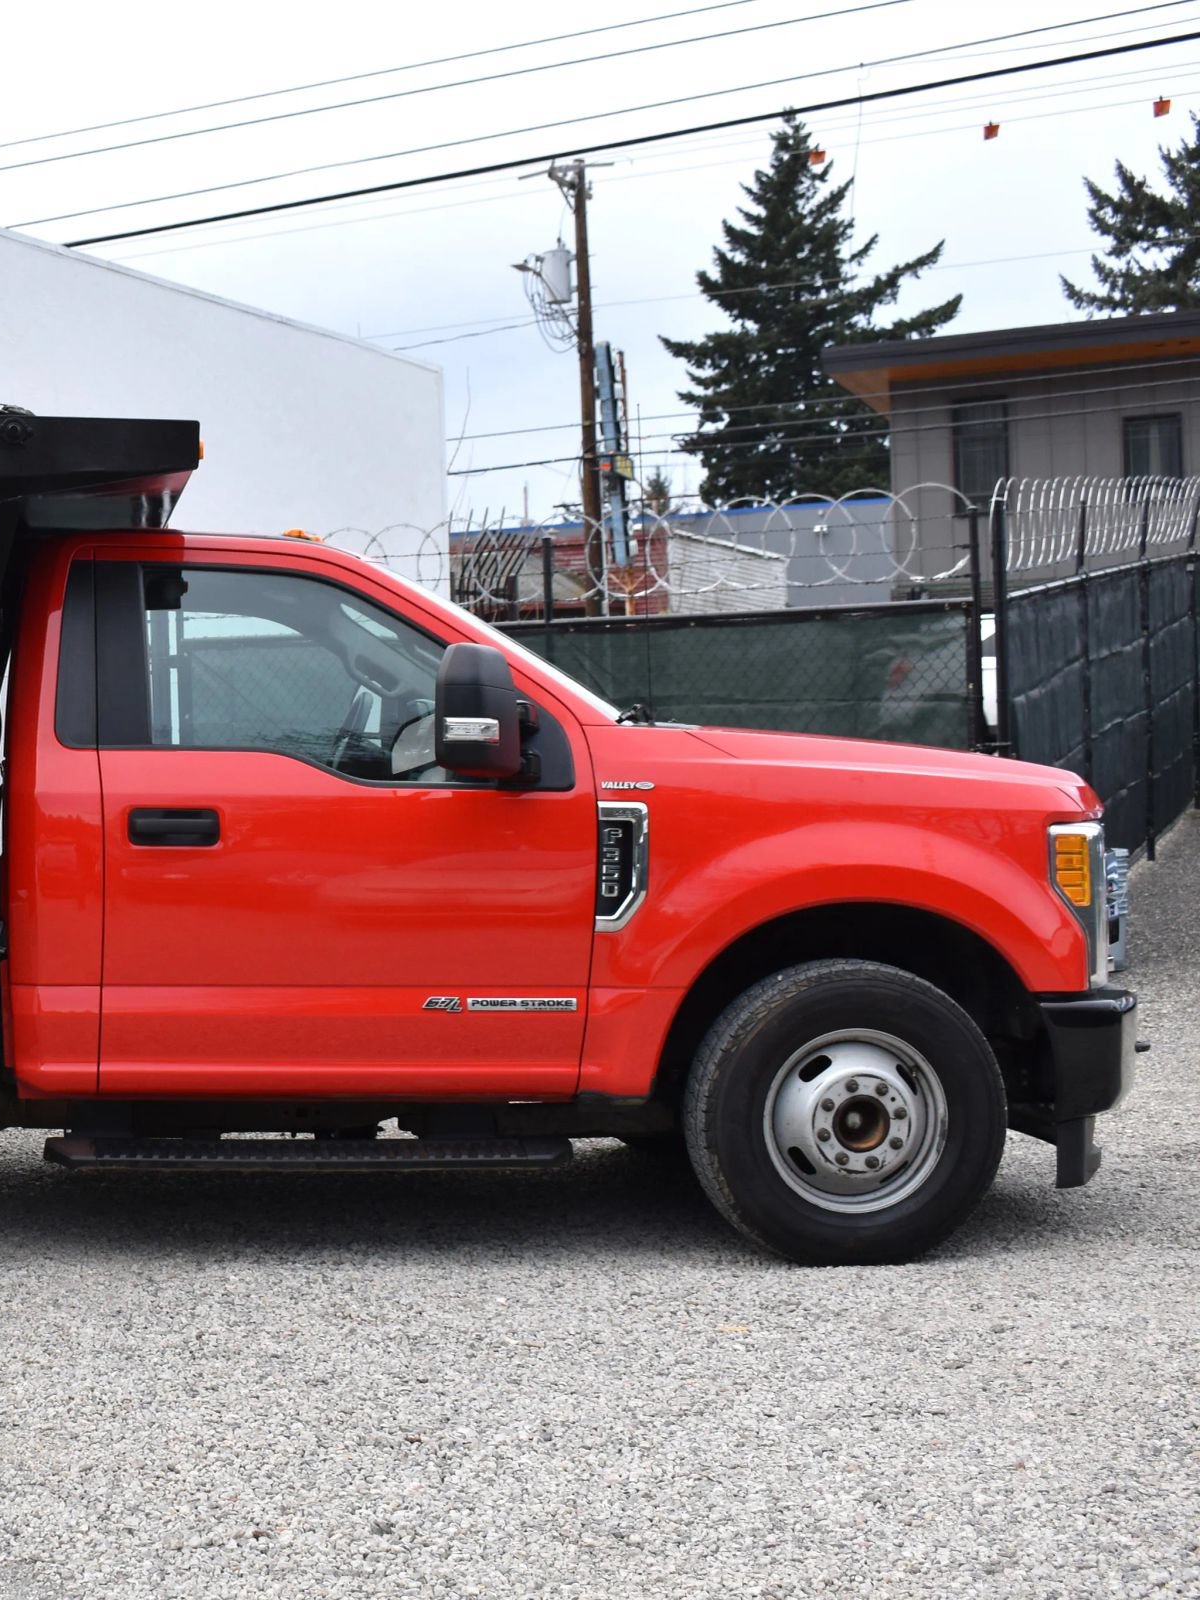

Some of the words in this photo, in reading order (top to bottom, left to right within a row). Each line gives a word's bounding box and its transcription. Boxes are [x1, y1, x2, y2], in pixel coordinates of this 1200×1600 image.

[601, 781, 636, 789] VALLEY
[471, 999, 517, 1007] POWER
[520, 999, 574, 1007] STROKE
